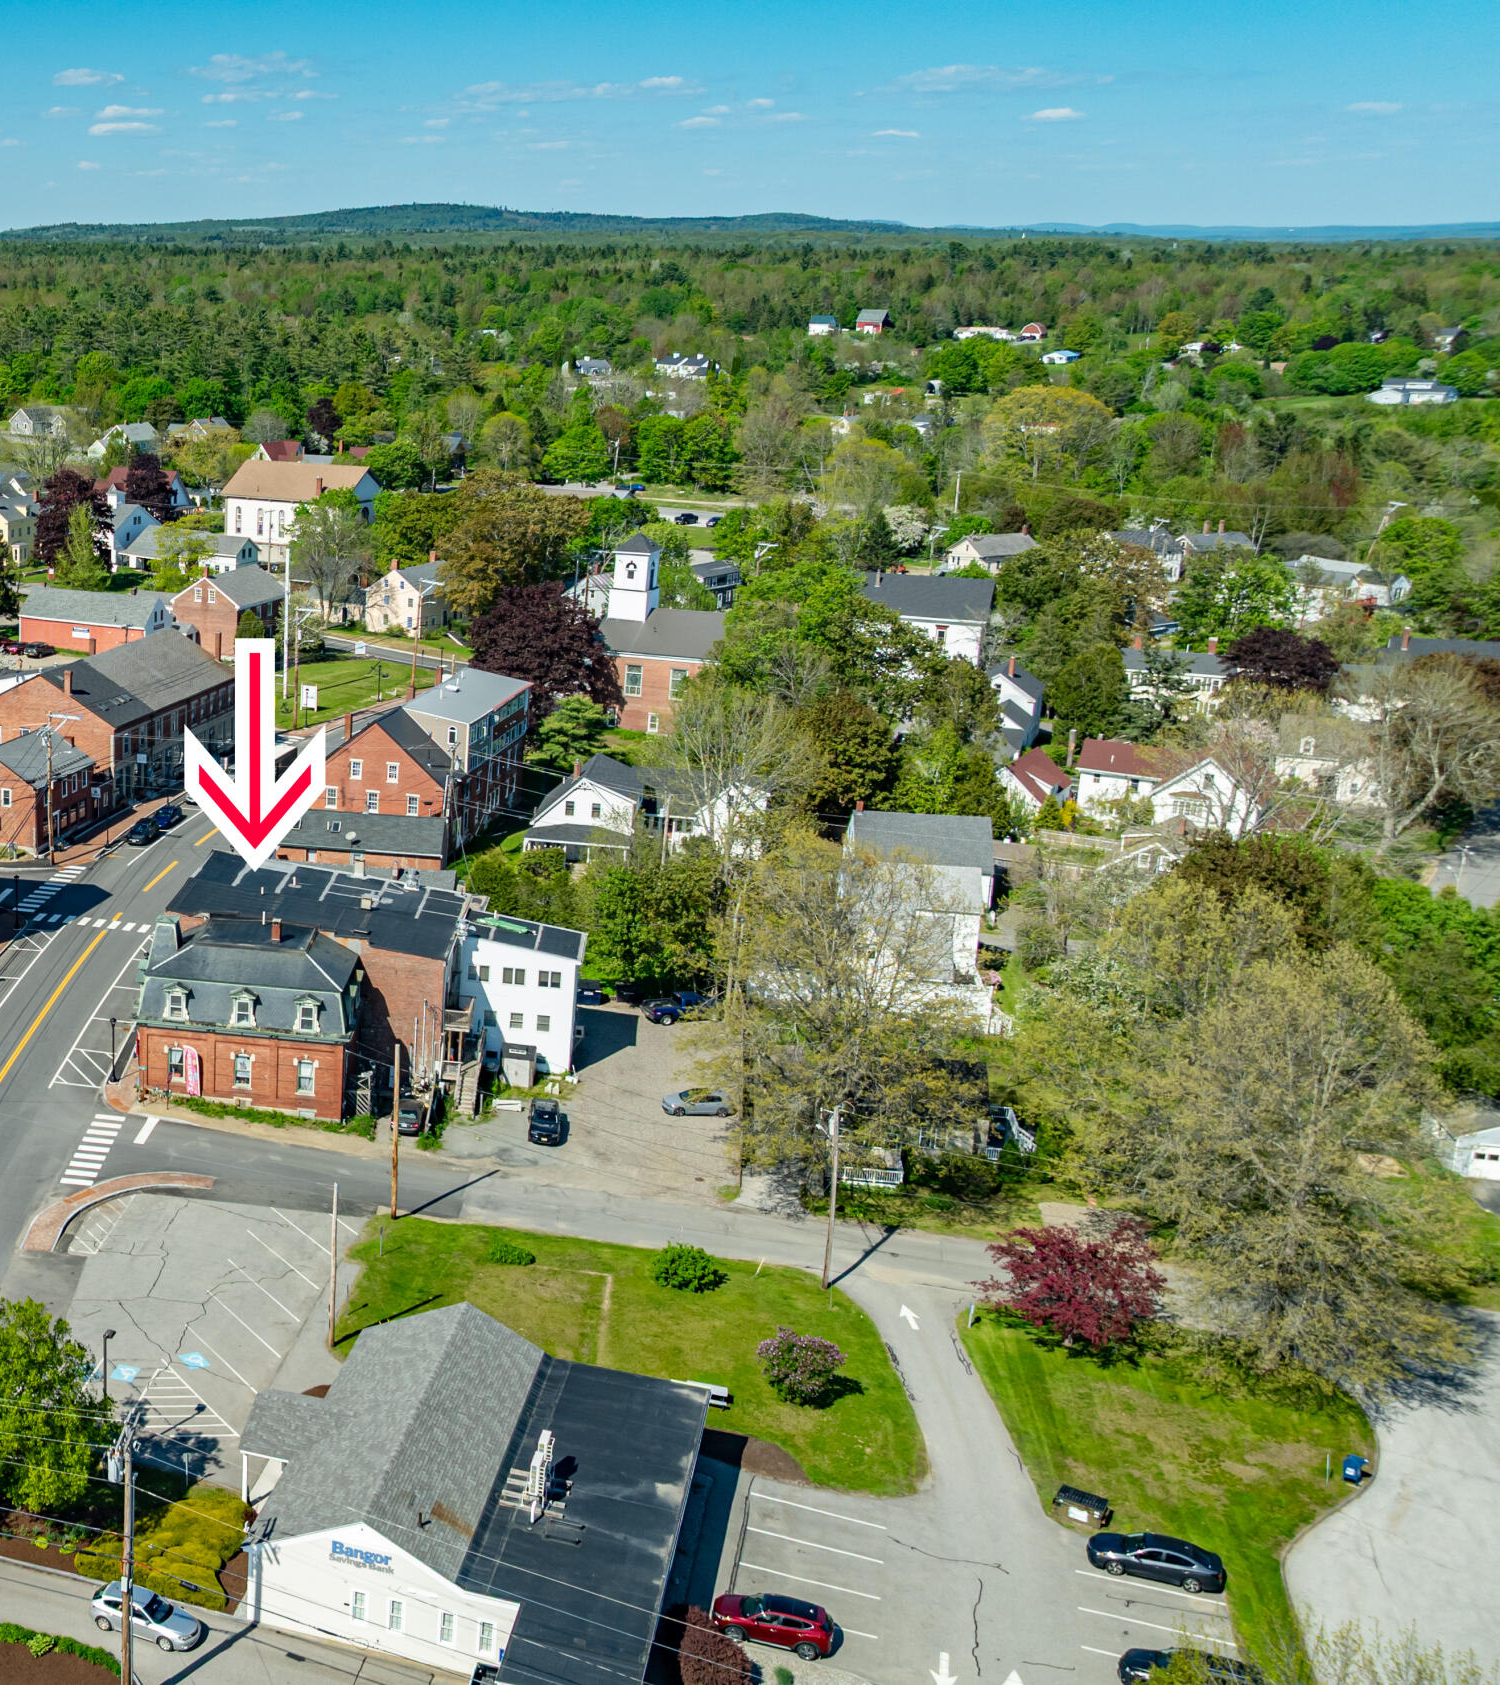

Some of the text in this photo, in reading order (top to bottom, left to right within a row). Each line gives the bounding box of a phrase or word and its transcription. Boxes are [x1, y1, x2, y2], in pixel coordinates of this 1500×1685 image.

[329, 1553, 395, 1575] Savings Bank
[332, 1540, 392, 1565] Bangor
